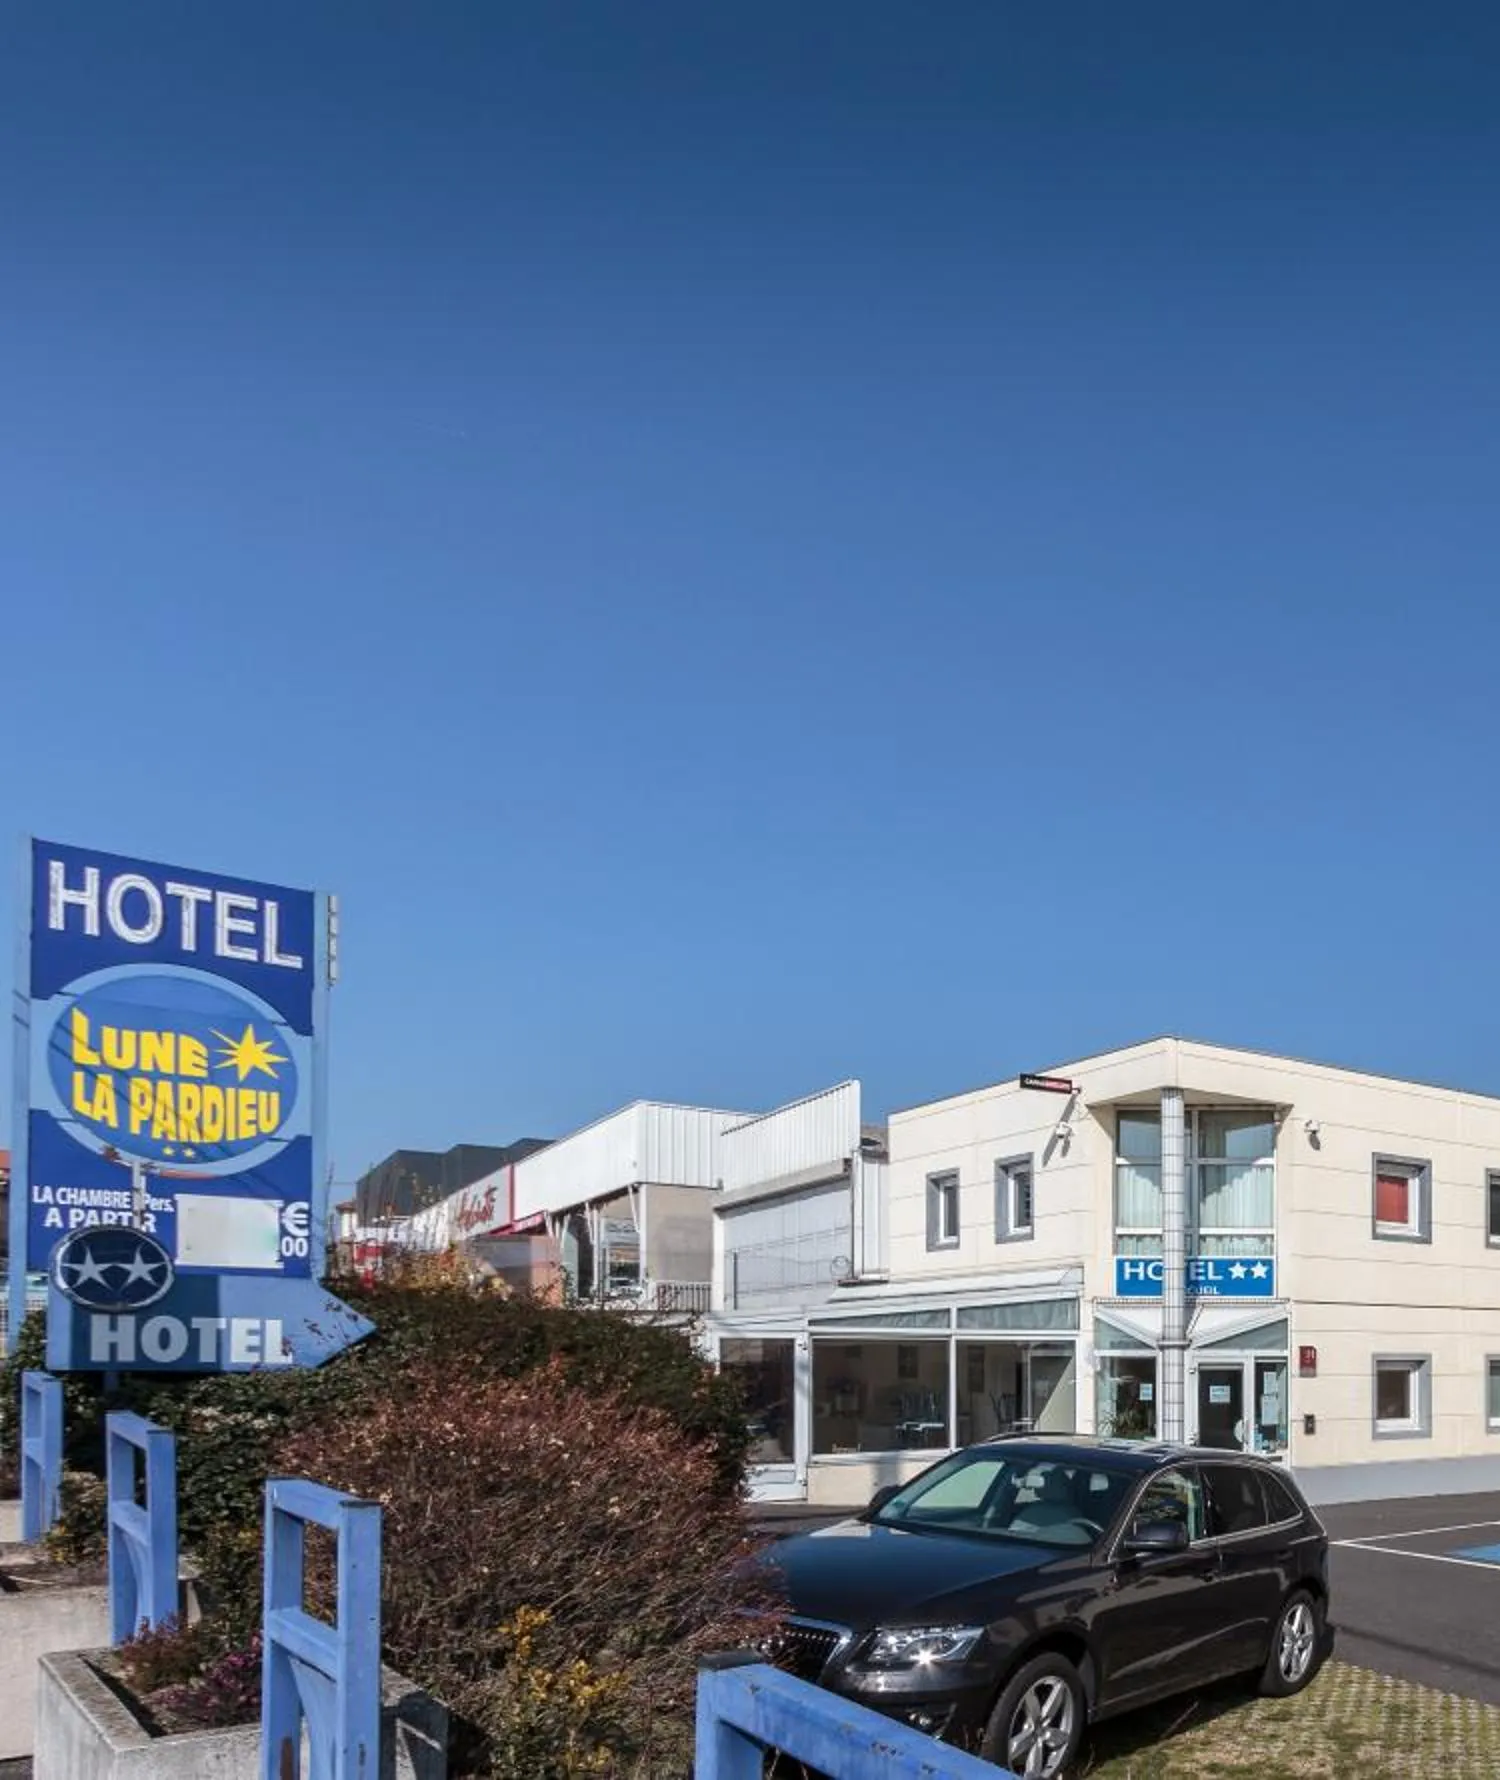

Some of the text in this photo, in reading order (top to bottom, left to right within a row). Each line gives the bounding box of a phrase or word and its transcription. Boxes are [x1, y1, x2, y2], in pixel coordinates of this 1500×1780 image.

[48, 859, 304, 970] HOTEL
[71, 1007, 209, 1078] LUNE
[72, 1070, 281, 1144] LA PARDIEU
[32, 1185, 54, 1204] LA
[56, 1187, 131, 1209] CHAMBRE
[42, 1207, 157, 1233] A PARTR
[281, 1236, 309, 1257] 00
[1123, 1261, 1224, 1281] HOEL
[90, 1313, 293, 1364] HOTEL
